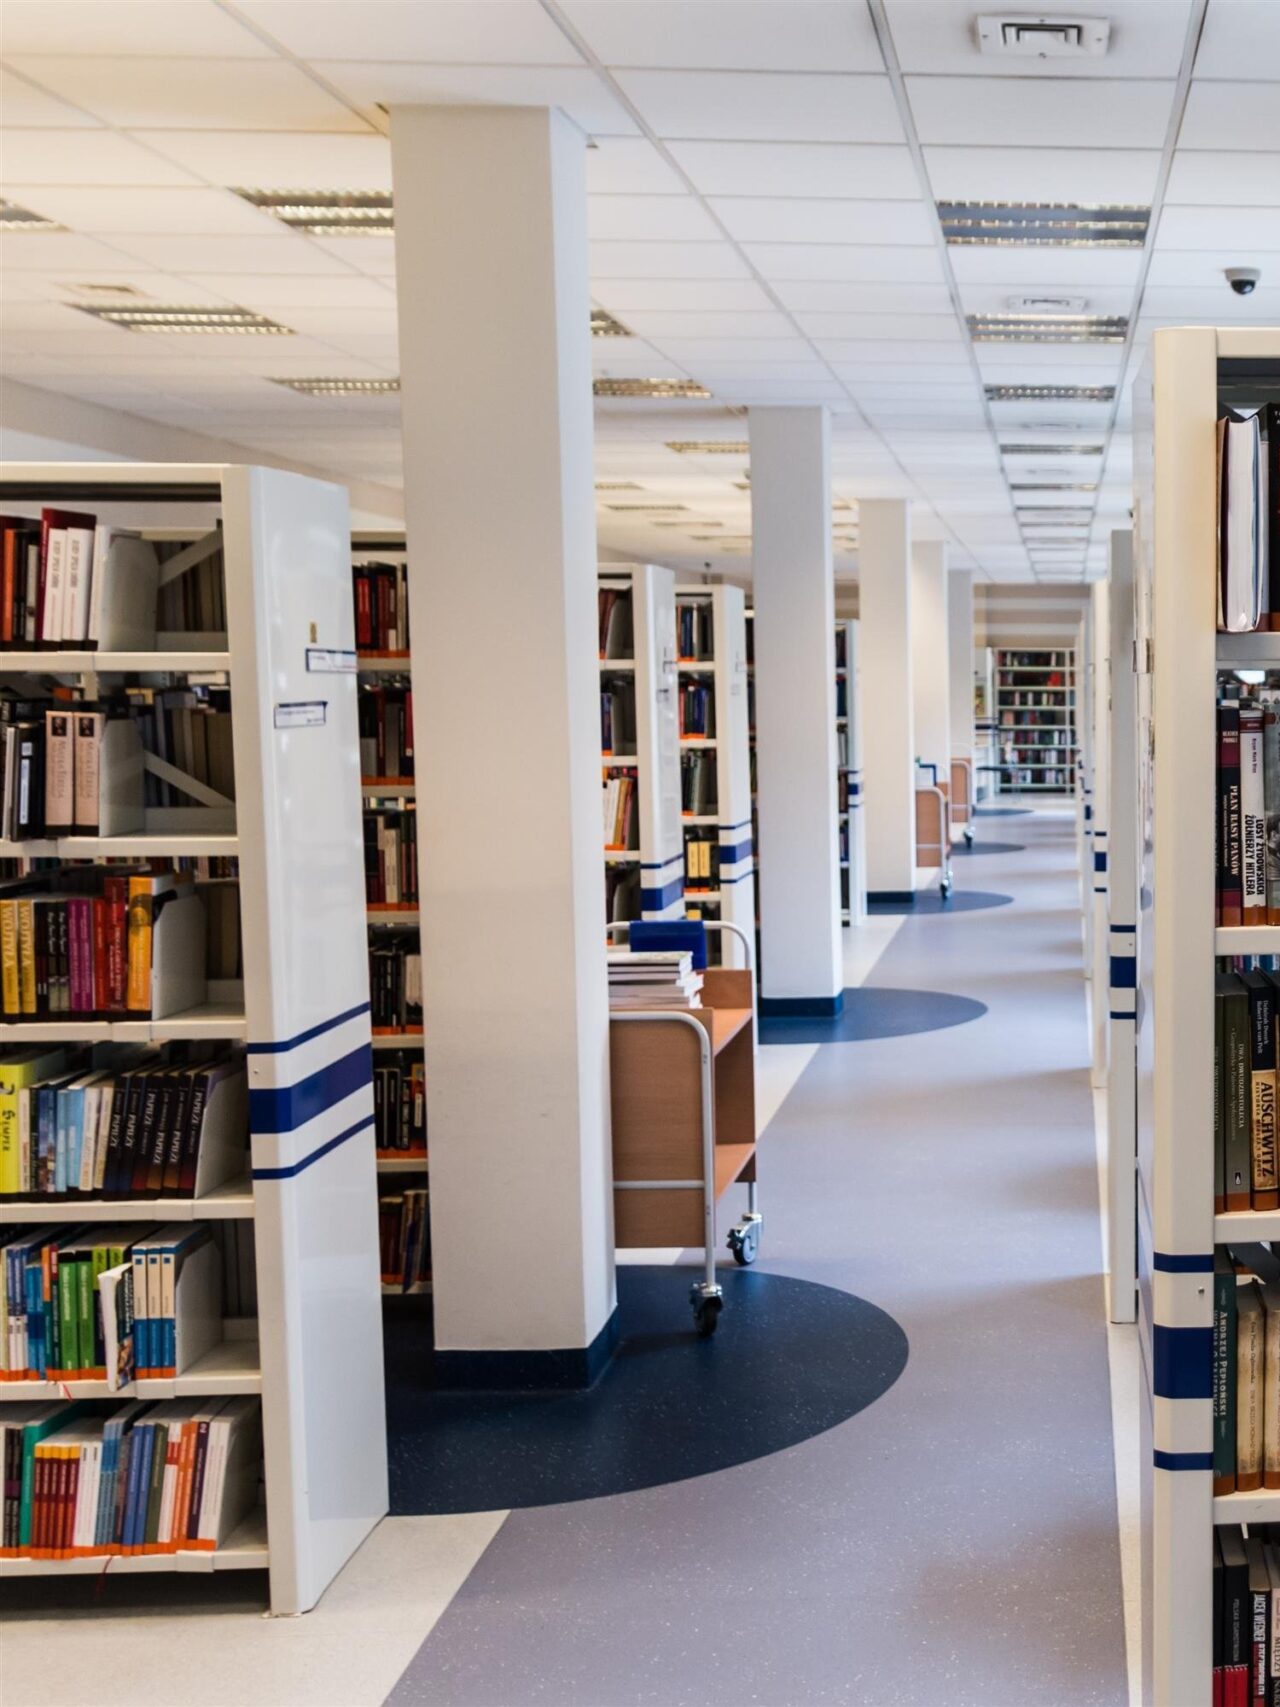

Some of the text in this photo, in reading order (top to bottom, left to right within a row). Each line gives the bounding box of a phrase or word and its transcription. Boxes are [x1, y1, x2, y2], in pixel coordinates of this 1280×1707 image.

[1230, 785, 1239, 876] PLAN RASY PANÓW
[1245, 815, 1256, 895] ŻOŁNIERZY HITLERA
[1255, 819, 1265, 895] LOSY ŻYDOWSKICH
[1261, 1082, 1274, 1176] AUSCHWITZ
[1273, 1637, 1280, 1674] MIĘDZY
